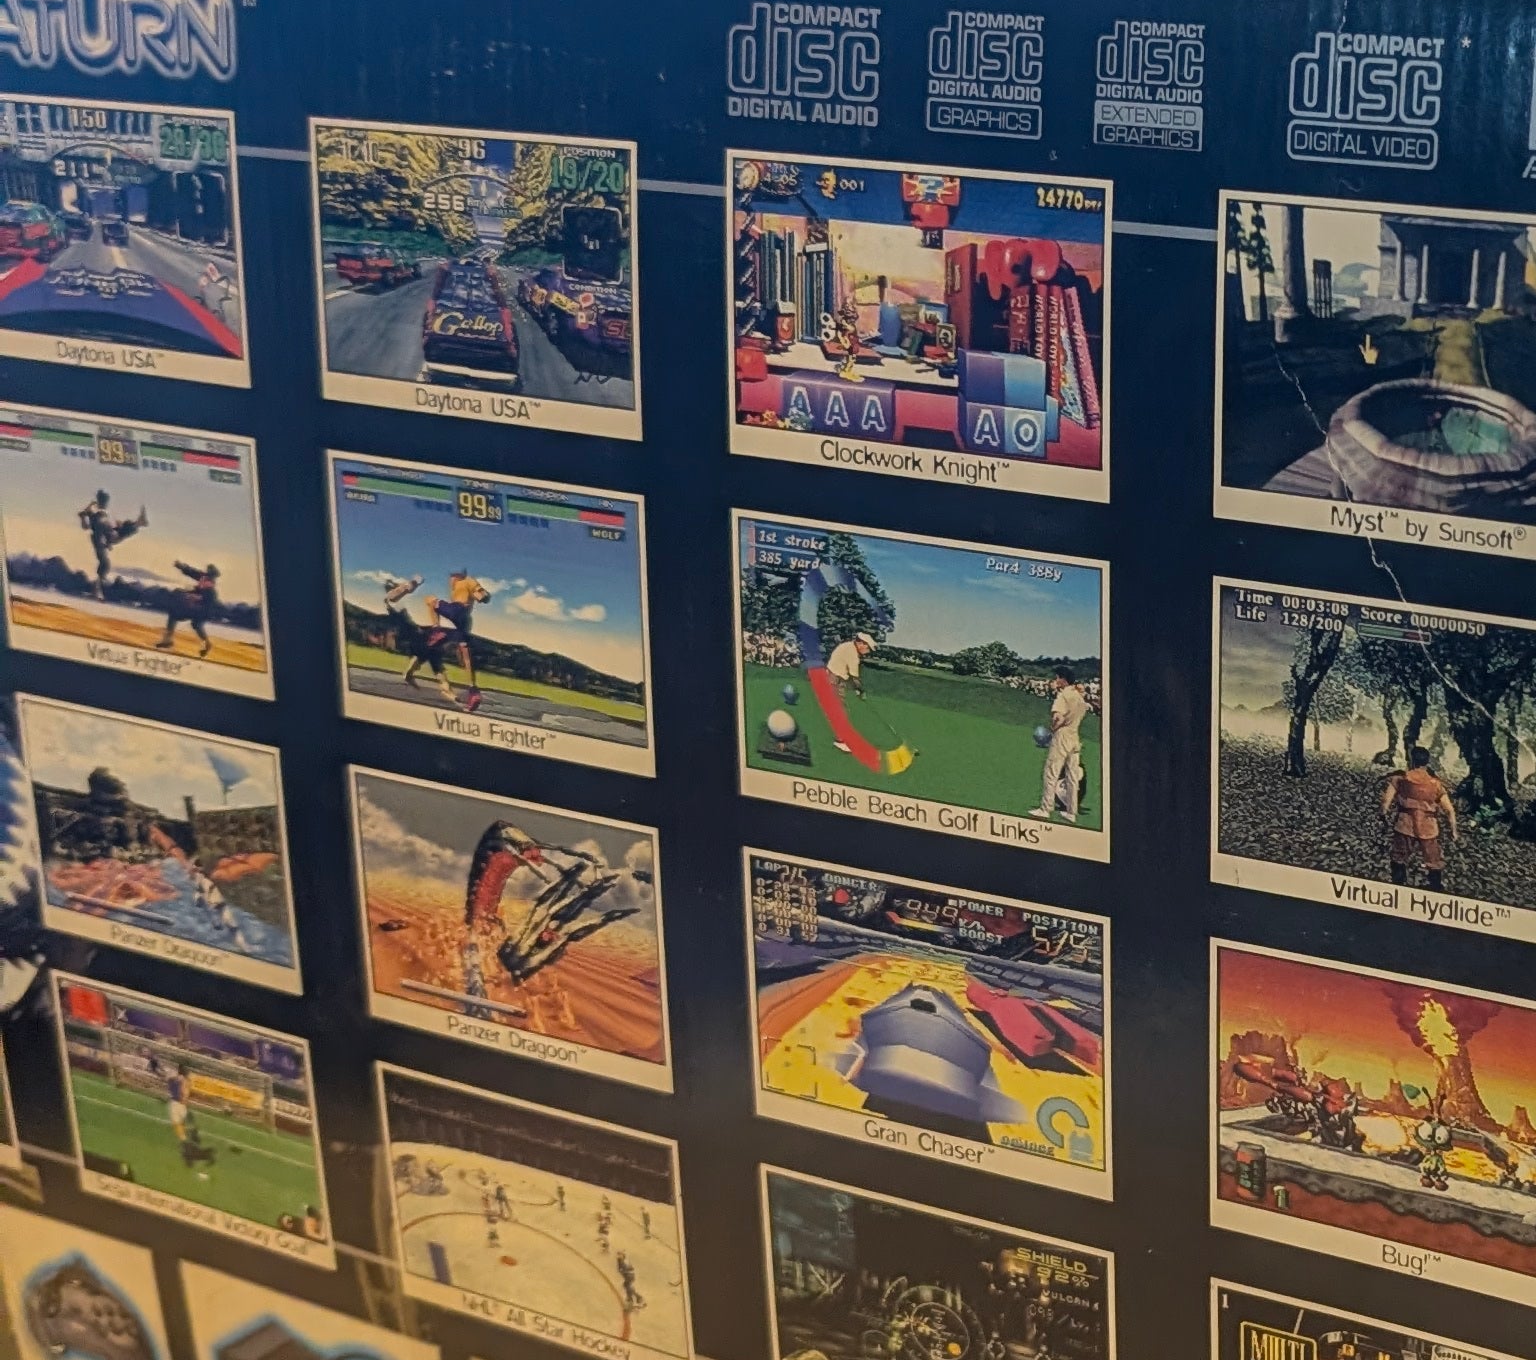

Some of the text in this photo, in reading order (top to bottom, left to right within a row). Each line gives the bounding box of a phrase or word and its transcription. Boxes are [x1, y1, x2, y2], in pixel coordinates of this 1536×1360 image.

[774, 4, 881, 29] COMPACT
[964, 11, 1044, 32] COMPACT
[1130, 21, 1206, 39] COMPACT
[1337, 33, 1445, 58] COMPACT
[928, 80, 1042, 103] DIGITAL AUDIO
[1096, 82, 1203, 104] DIGITAL AUDIO
[728, 96, 879, 128] DIGITAL AUDIO
[936, 107, 1033, 132] GRAPHICS
[1100, 105, 1197, 127] EXTENDED
[1101, 127, 1195, 149] GRAPHICS
[1293, 130, 1432, 159] DIGITAL VIDEO
[423, 192, 466, 212] 256
[56, 340, 116, 367] Daytona
[415, 387, 482, 415] Daytona
[820, 440, 923, 474] Clockwork
[458, 491, 487, 519] 99
[591, 528, 623, 541] WOLF
[758, 529, 826, 552] 1st stroke
[1404, 516, 1429, 543] by
[758, 550, 821, 571] 385 yard
[985, 557, 1021, 576] Par4
[1235, 604, 1344, 633] Life 128/200
[1236, 588, 1487, 637] Time 00:03:08 Score 00000050
[433, 711, 481, 738] Virtua
[792, 780, 858, 811] Pebble
[868, 795, 928, 823] Beach
[938, 807, 979, 834] Golf
[1329, 876, 1400, 910] Virtual
[958, 898, 1005, 918] POWER
[958, 927, 1005, 945] BOOST
[1022, 911, 1099, 936] POSITION
[446, 1014, 501, 1041] Panzer
[863, 1118, 909, 1146] Gran
[1016, 1246, 1088, 1273] SHIELD
[1221, 1293, 1230, 1309] 1
